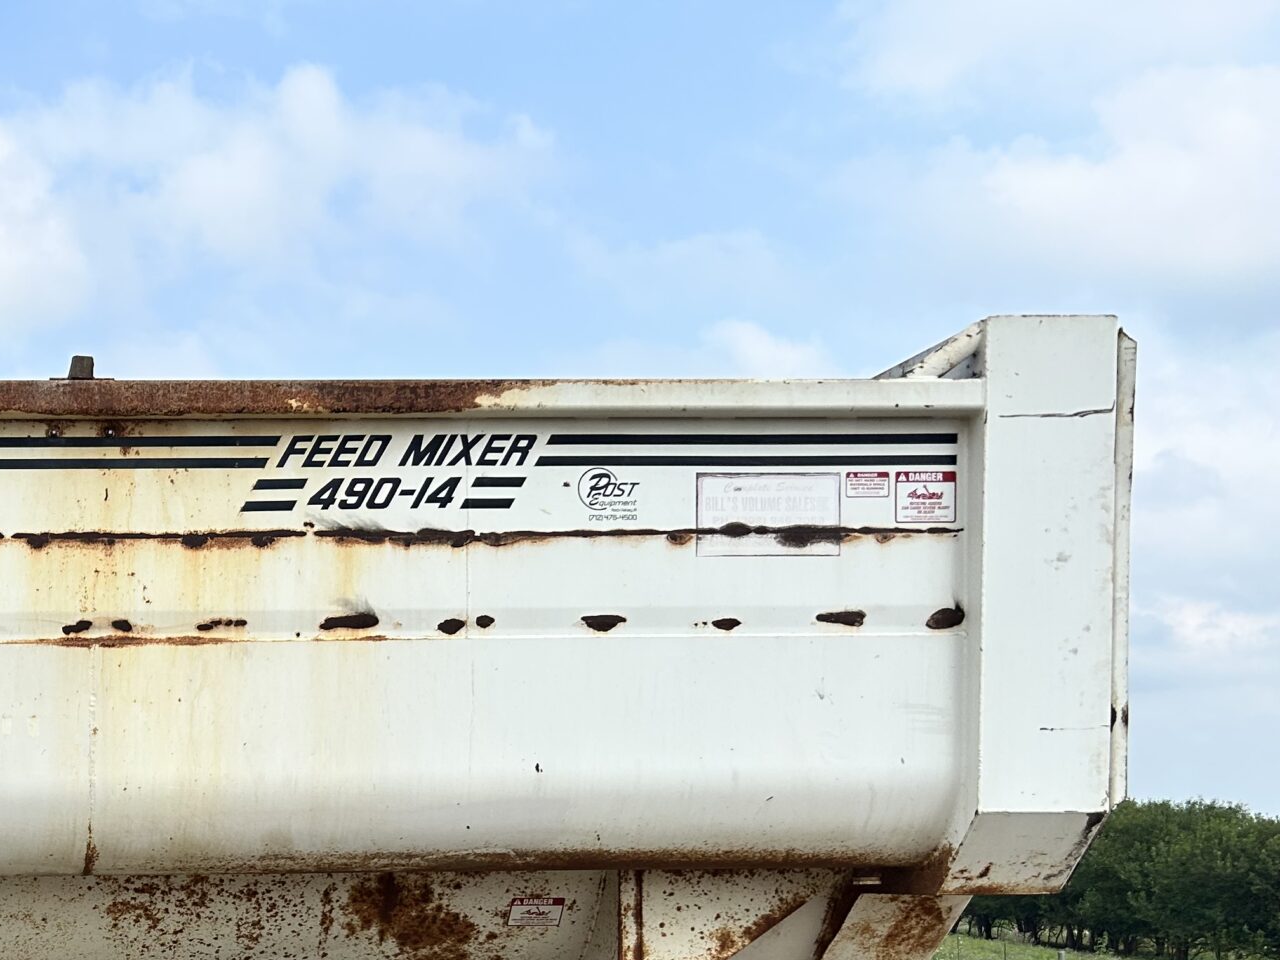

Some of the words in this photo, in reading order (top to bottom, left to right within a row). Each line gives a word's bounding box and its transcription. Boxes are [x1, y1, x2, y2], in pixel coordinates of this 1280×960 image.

[276, 435, 392, 467] FEED
[398, 434, 537, 467] MIXER
[587, 473, 640, 498] POST
[908, 472, 943, 481] DANGER
[307, 477, 462, 510] 490-14
[589, 492, 637, 507] Equipment
[785, 496, 816, 512] SALES
